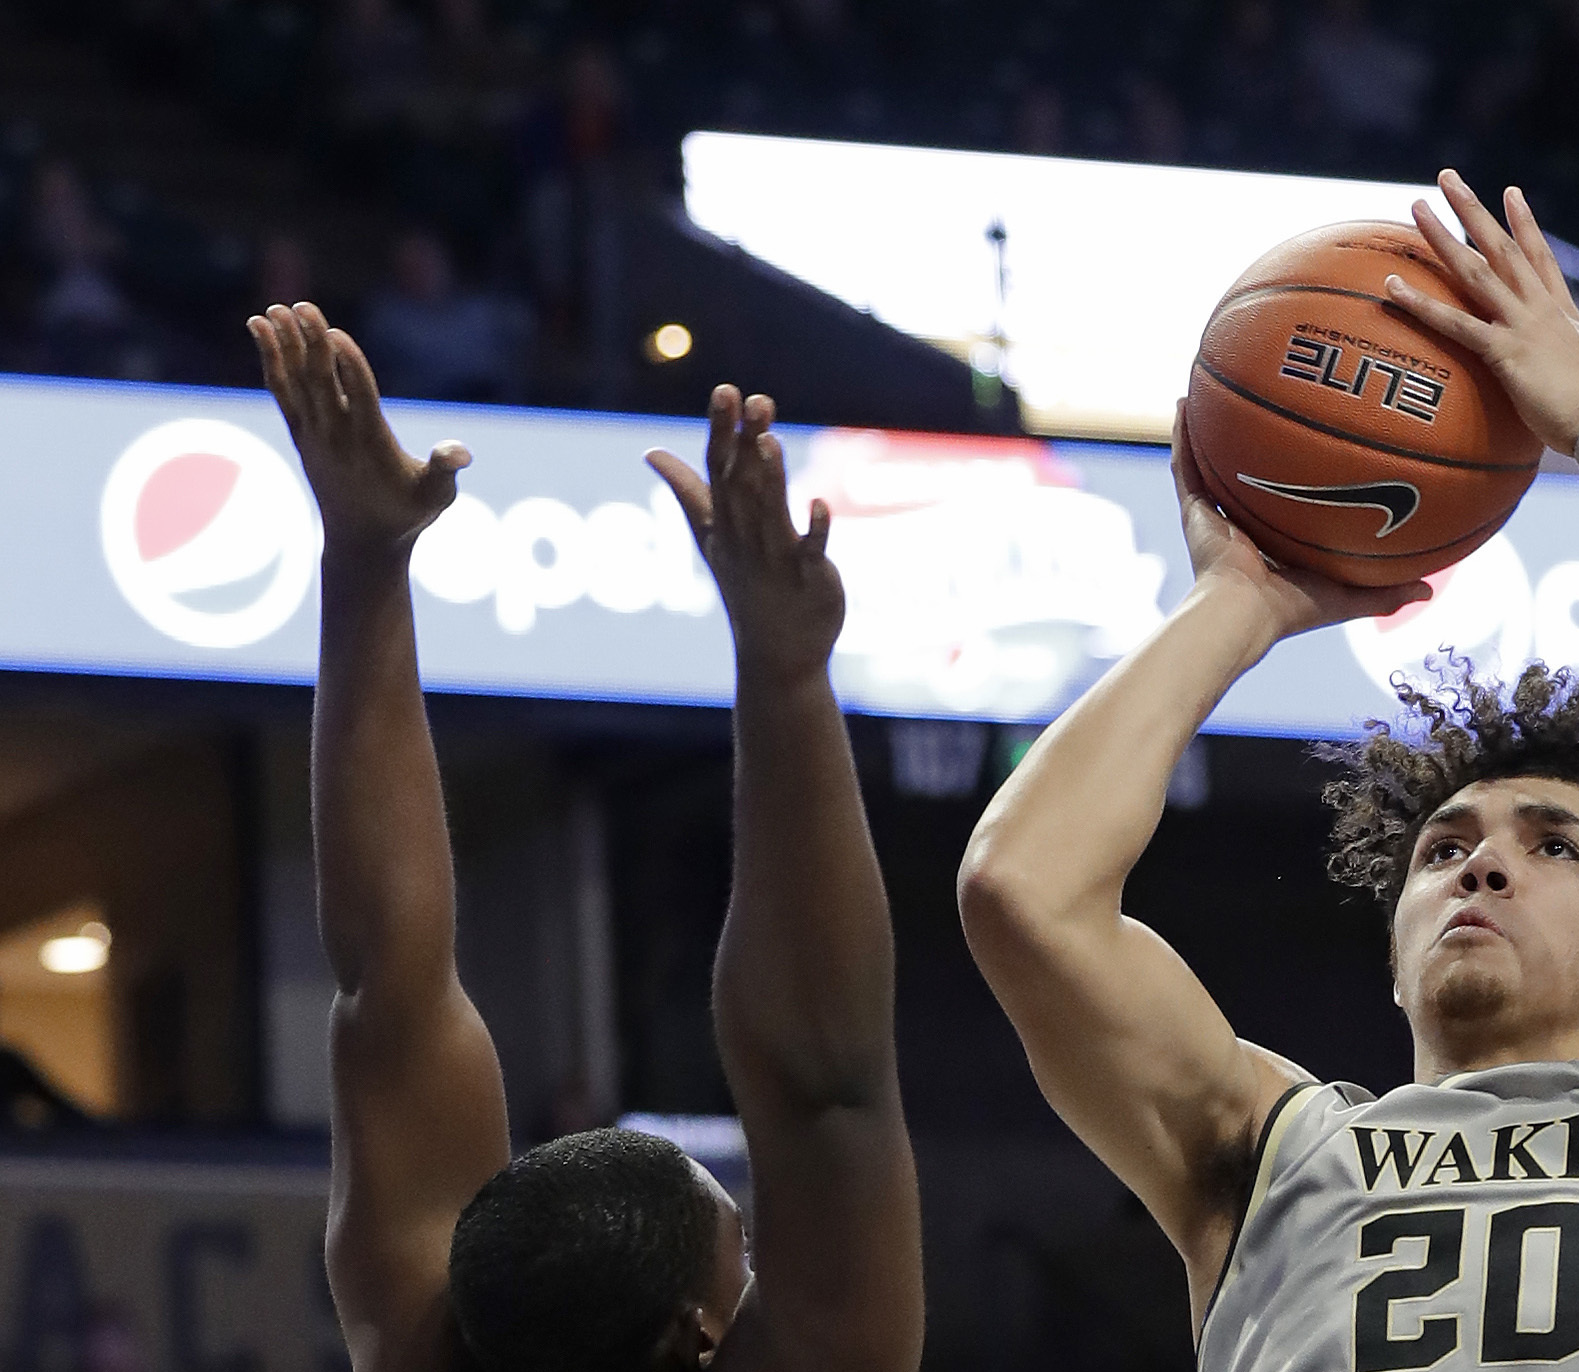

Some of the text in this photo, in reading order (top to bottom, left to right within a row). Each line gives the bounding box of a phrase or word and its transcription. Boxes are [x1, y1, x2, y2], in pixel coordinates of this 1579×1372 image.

[1279, 333, 1446, 426] ELITE
[1295, 322, 1452, 381] CHAMPIONSHIP
[408, 485, 714, 634] epsi
